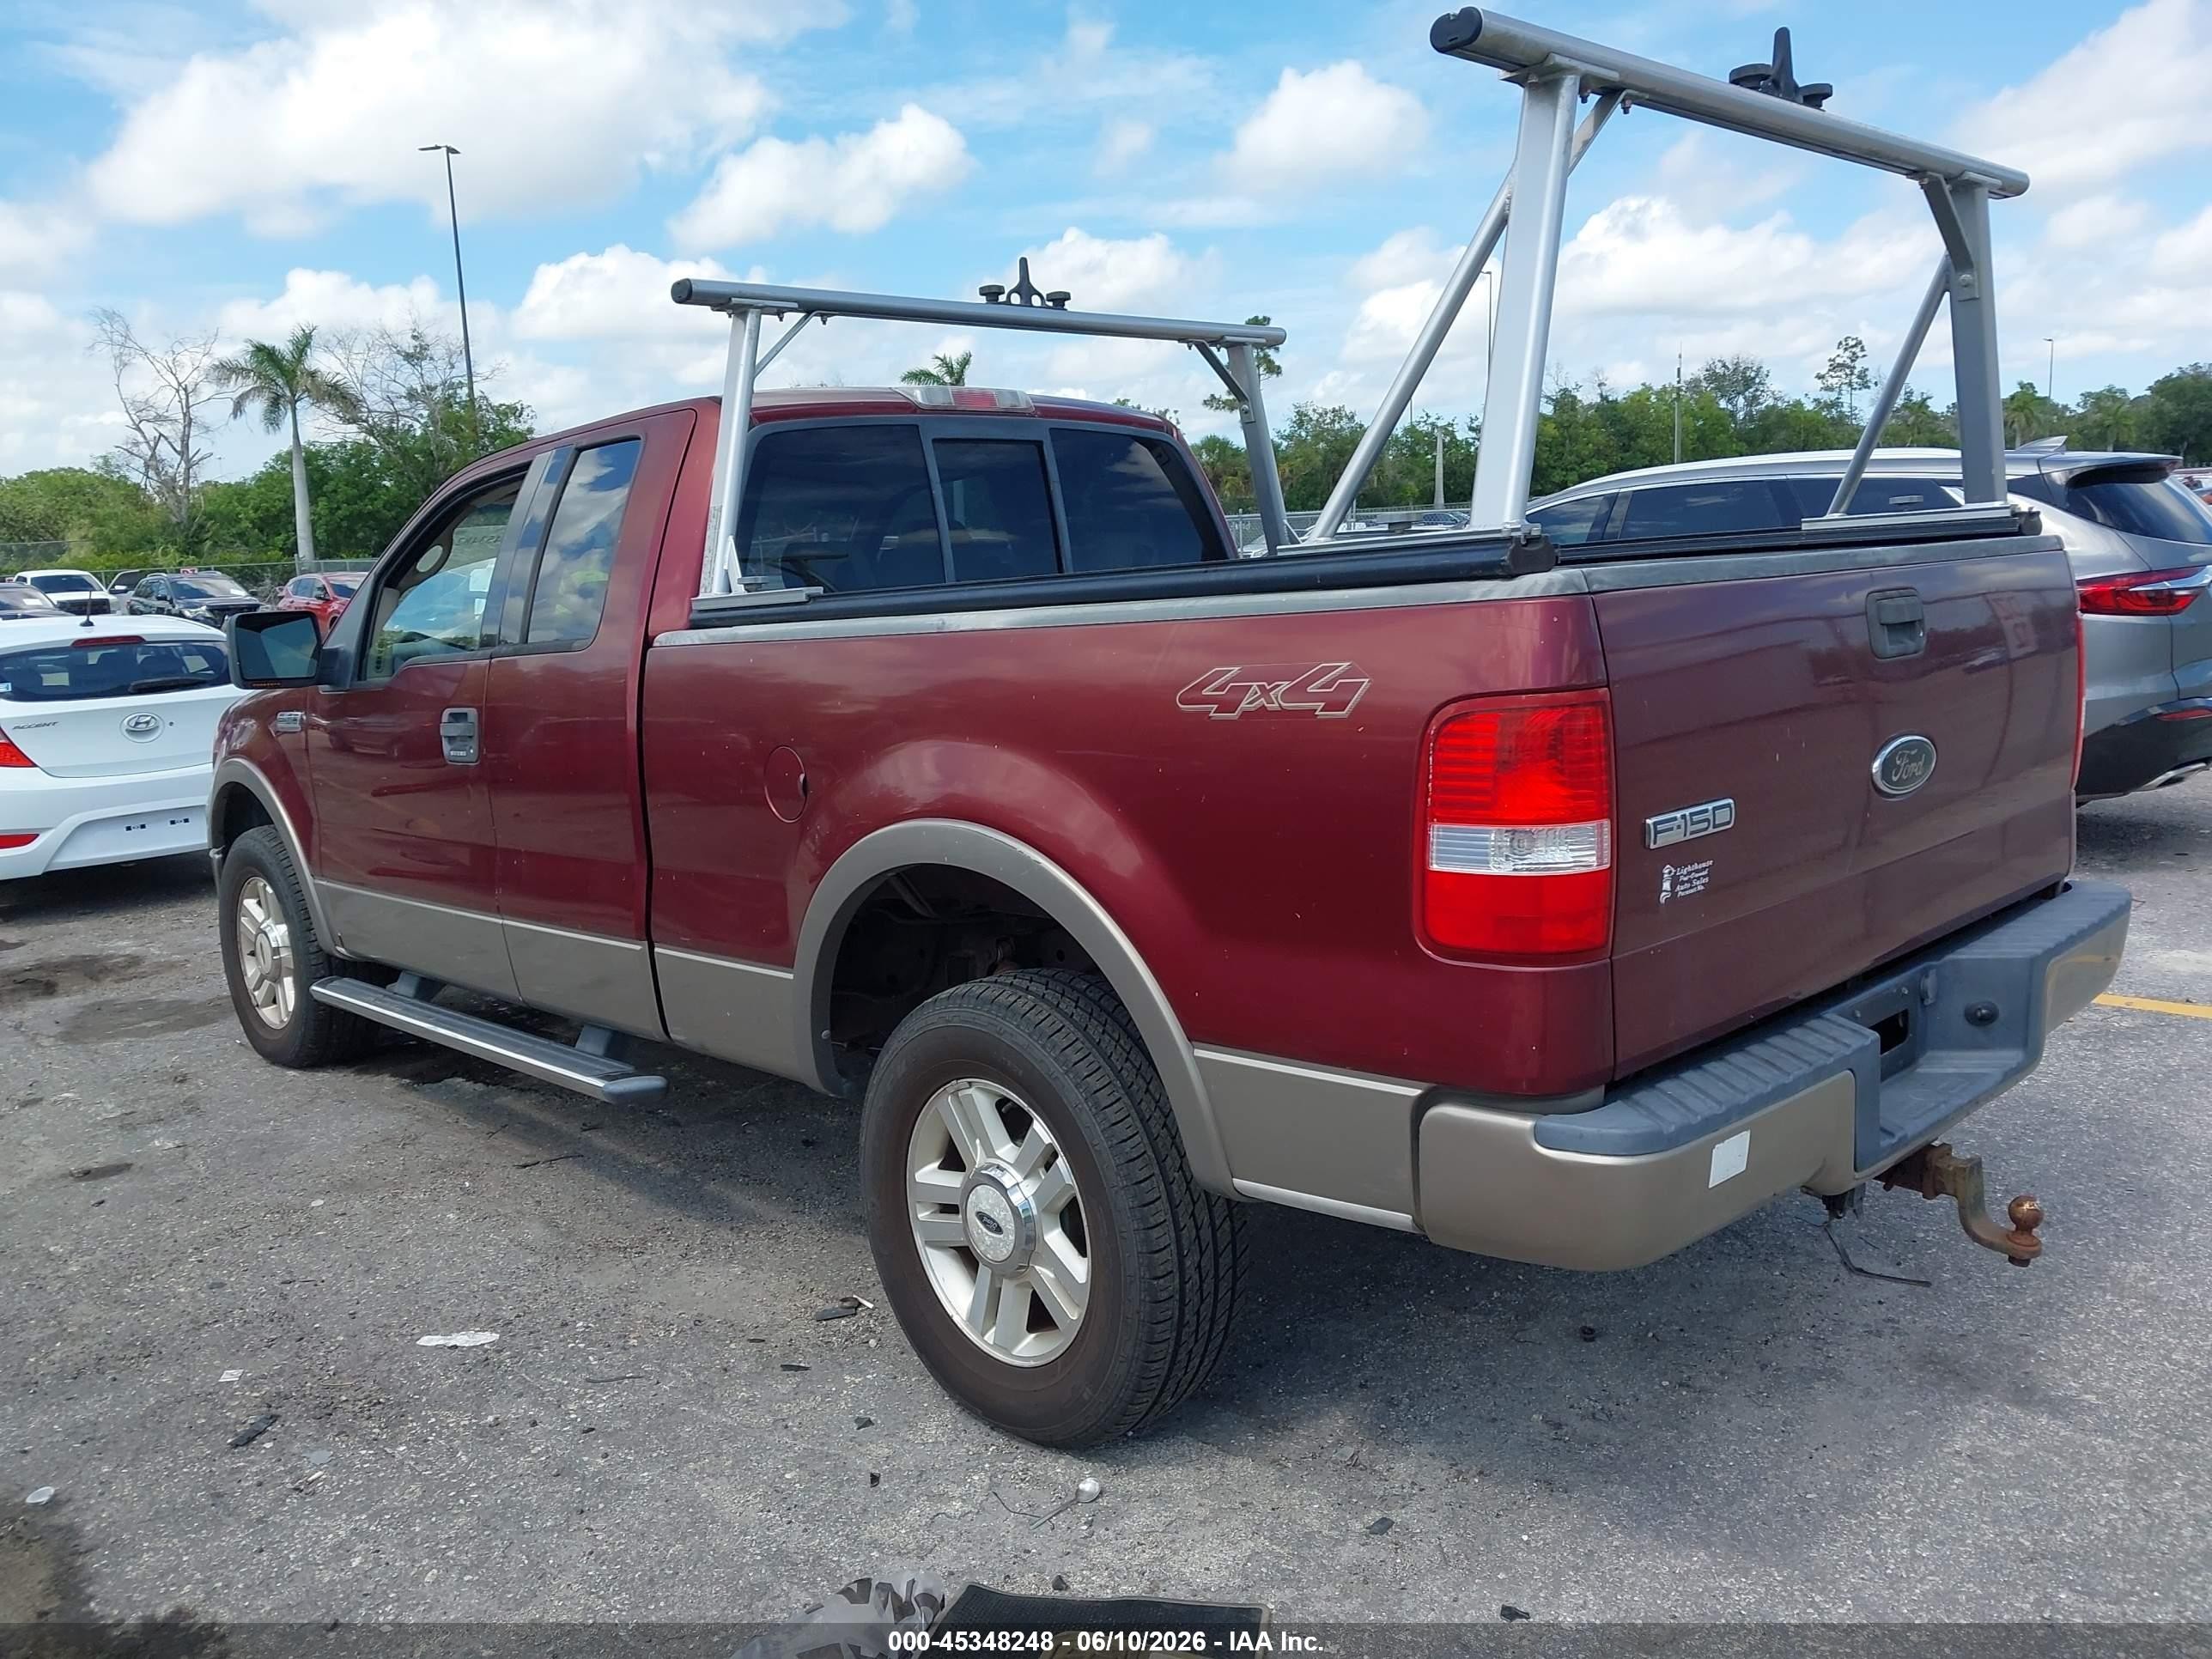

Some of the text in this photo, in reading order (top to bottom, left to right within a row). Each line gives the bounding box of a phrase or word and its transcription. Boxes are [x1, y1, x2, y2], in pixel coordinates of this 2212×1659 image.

[1176, 662, 1370, 720] 4x4
[12, 721, 59, 730] ACCENT
[1892, 748, 1925, 781] Ford
[1676, 860, 1714, 876] Lighthouse
[1674, 883, 1691, 892] Auto
[1691, 877, 1710, 887] Sales
